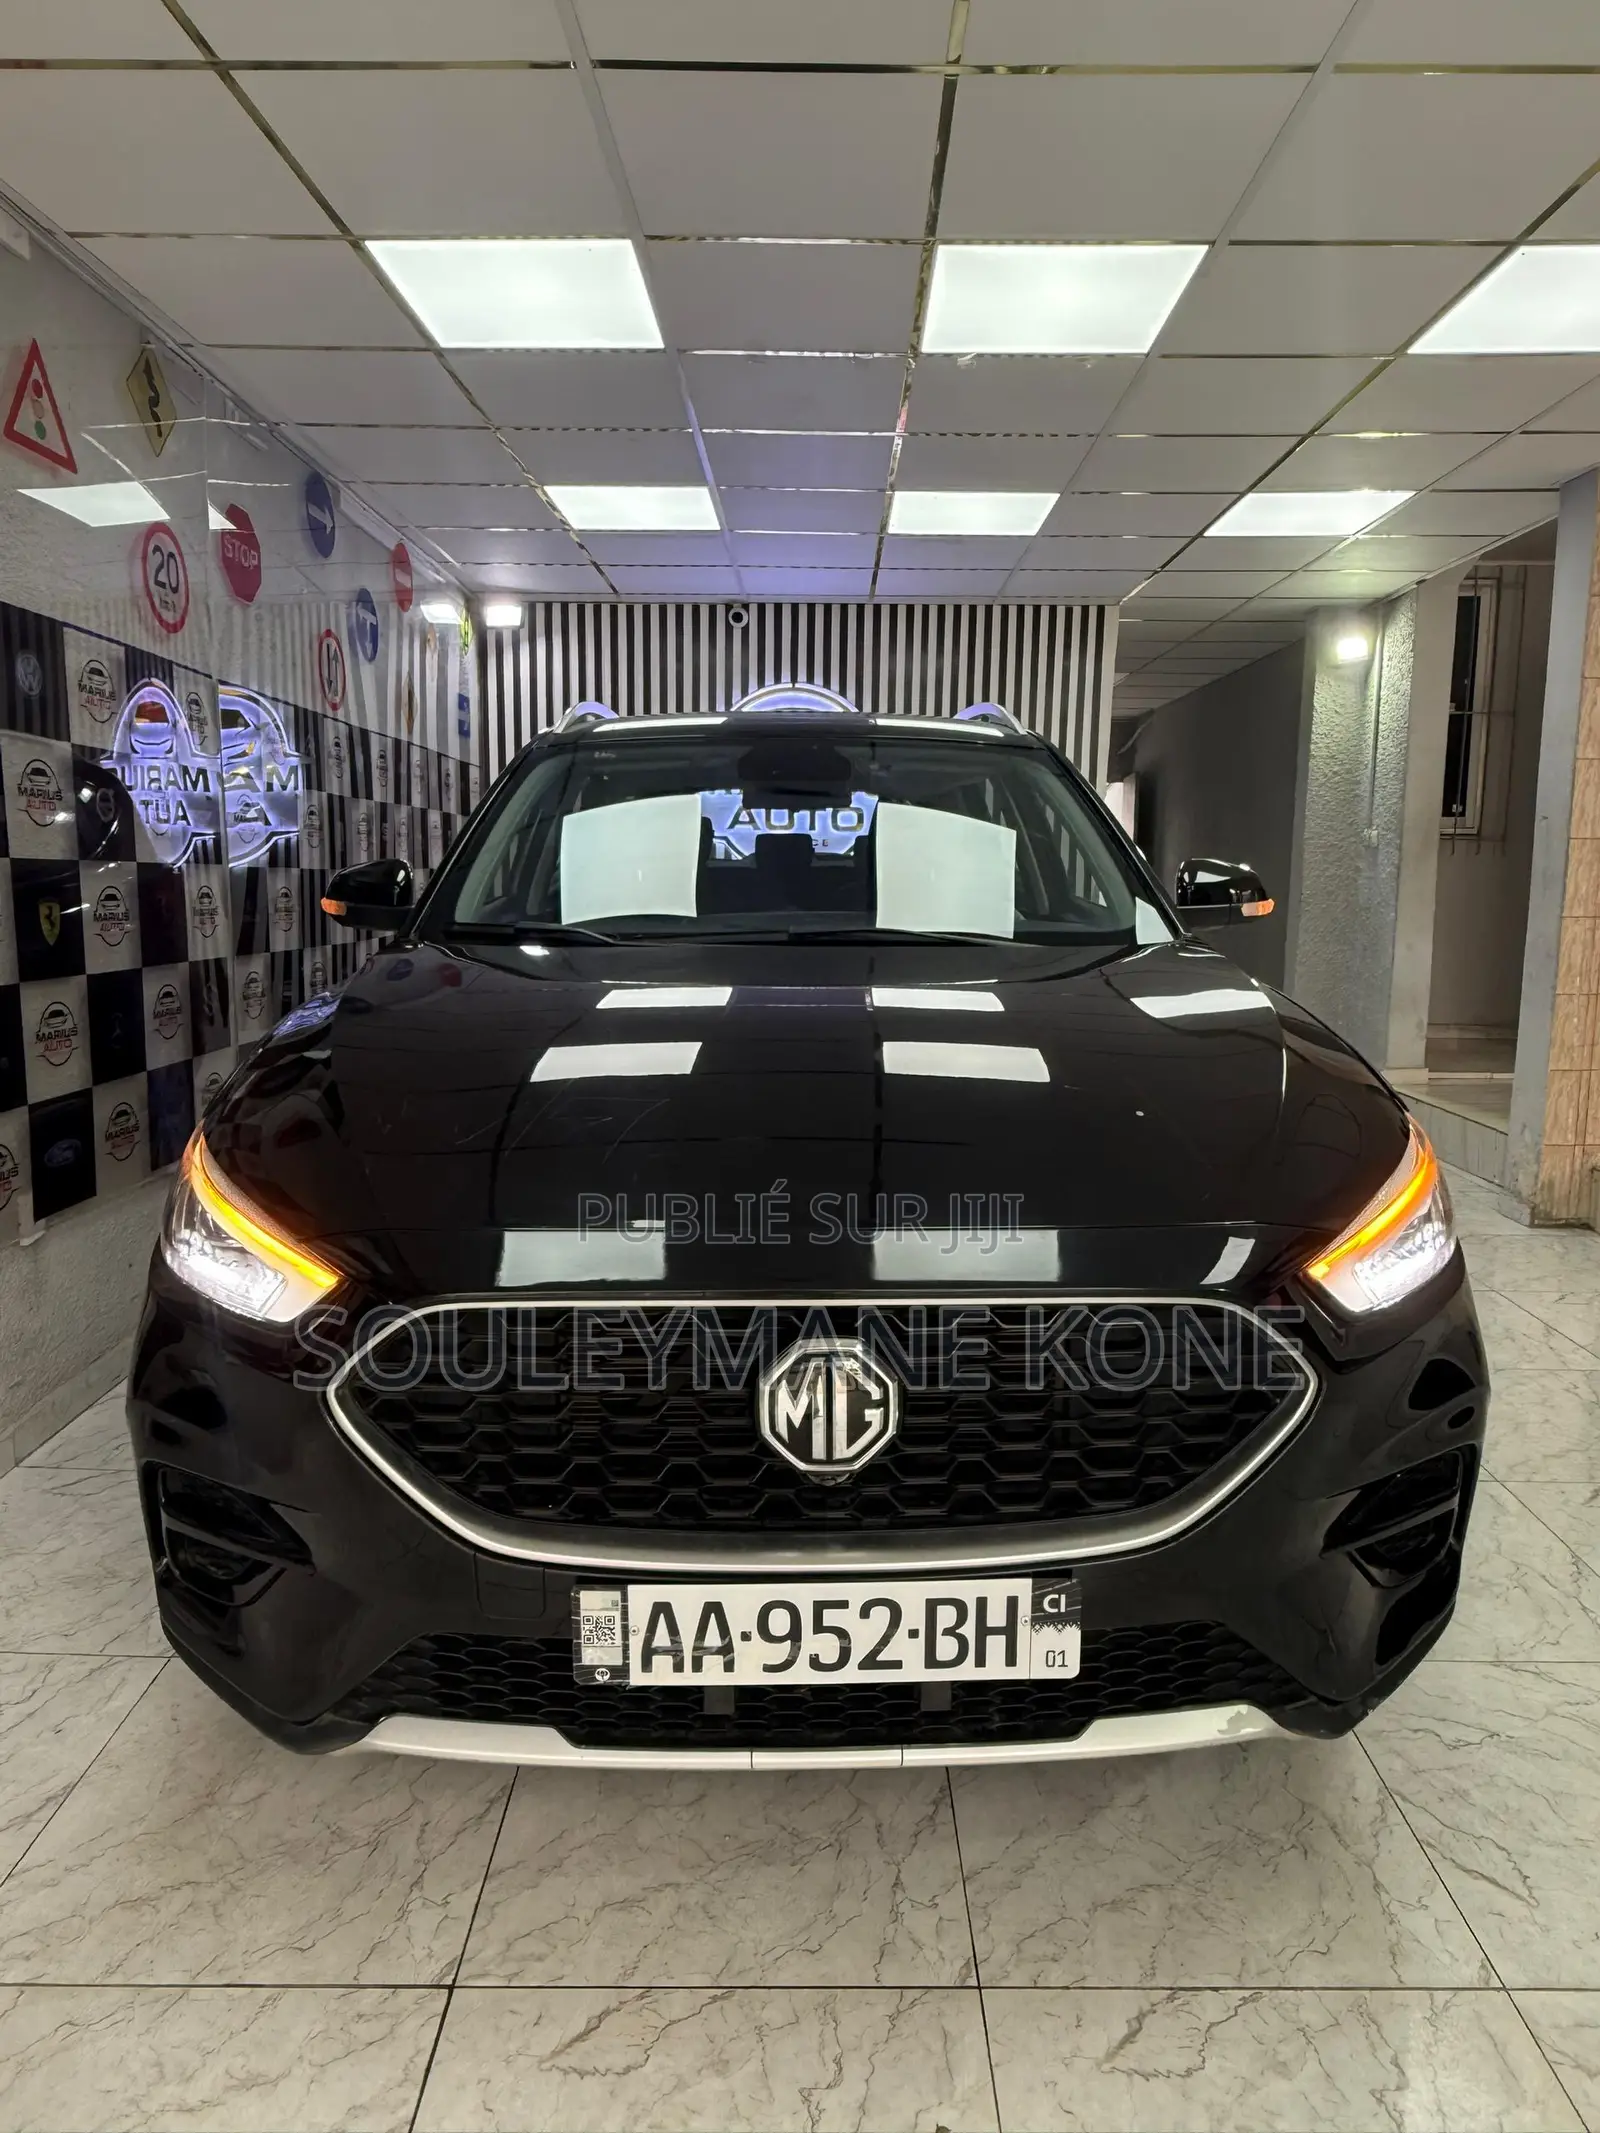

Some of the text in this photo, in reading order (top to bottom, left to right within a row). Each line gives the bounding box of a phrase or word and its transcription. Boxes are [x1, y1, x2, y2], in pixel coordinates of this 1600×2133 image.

[223, 534, 259, 570] STOP
[152, 544, 180, 594] 20
[17, 785, 63, 801] MARIUS
[727, 806, 864, 832] AUTO
[93, 910, 129, 922] MARIUS
[36, 1025, 78, 1043] MARIUS
[43, 1038, 73, 1052] AUTO
[775, 1357, 884, 1460] MG
[1043, 1594, 1066, 1613] CI
[1045, 1650, 1069, 1668] 01
